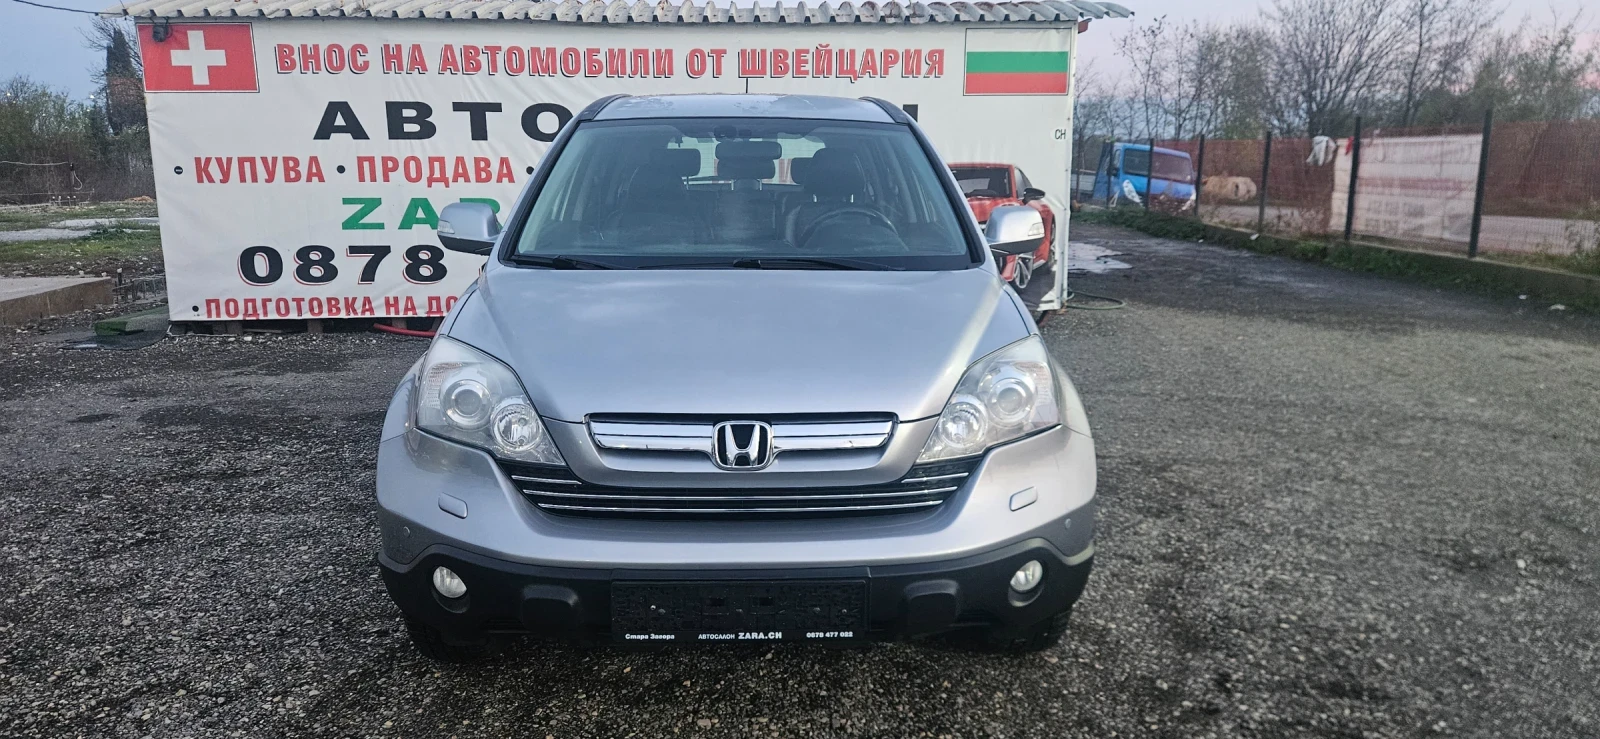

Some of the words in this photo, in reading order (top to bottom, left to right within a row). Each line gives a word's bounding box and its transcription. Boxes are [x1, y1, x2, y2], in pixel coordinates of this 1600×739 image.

[275, 43, 371, 75] ВНОС
[381, 44, 428, 75] НА
[438, 45, 675, 79] АВТОМОБИЛИ
[685, 48, 727, 79] ОТ
[737, 44, 945, 82] ШВЕЙЦАРИЯ
[194, 156, 325, 184] КУПУВА
[357, 156, 515, 188] ПРОДАВА
[238, 245, 448, 285] 0878
[205, 296, 375, 320] ПОДГОТОВКА
[384, 296, 417, 316] НА
[738, 631, 782, 640] ZARA.CH
